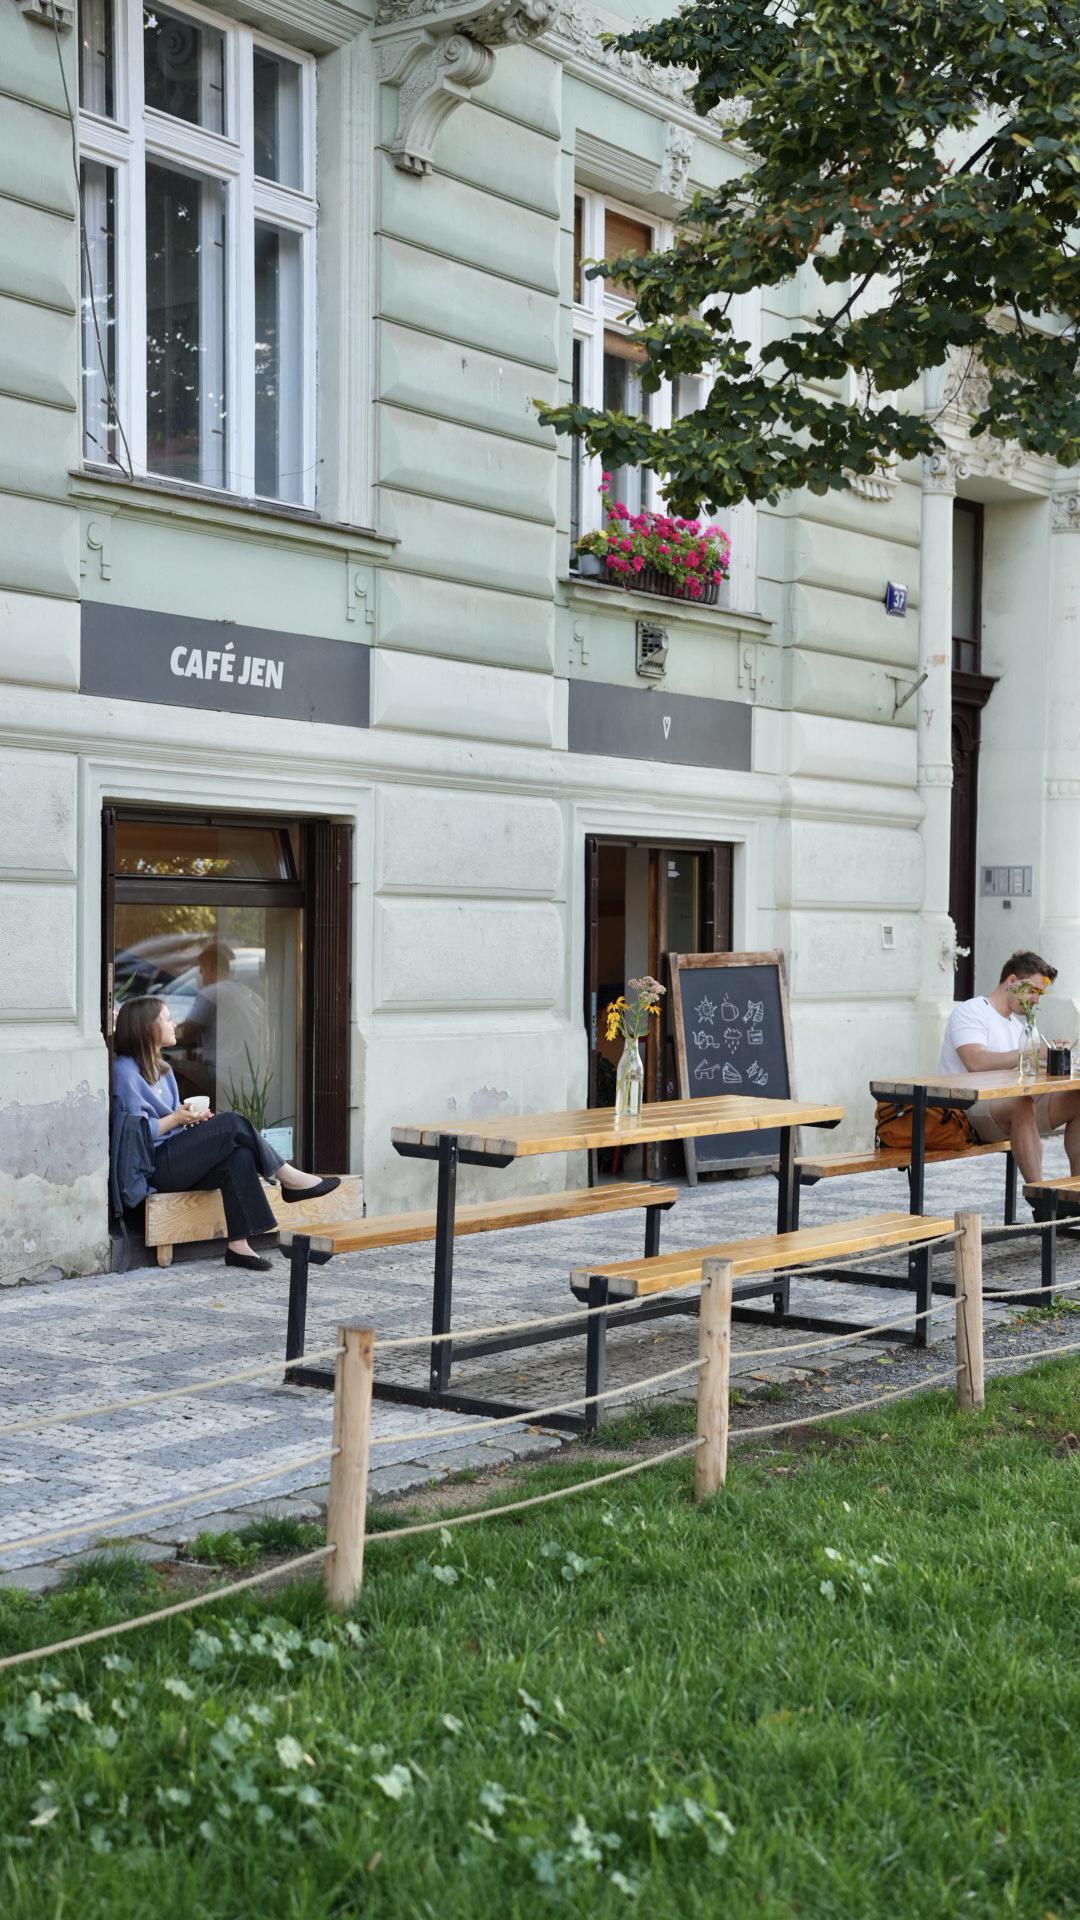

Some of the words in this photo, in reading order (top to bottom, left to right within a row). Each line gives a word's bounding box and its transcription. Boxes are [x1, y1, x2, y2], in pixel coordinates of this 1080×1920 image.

[893, 590, 905, 608] 37
[170, 641, 236, 683] CAFÉ
[237, 655, 284, 689] JEN
